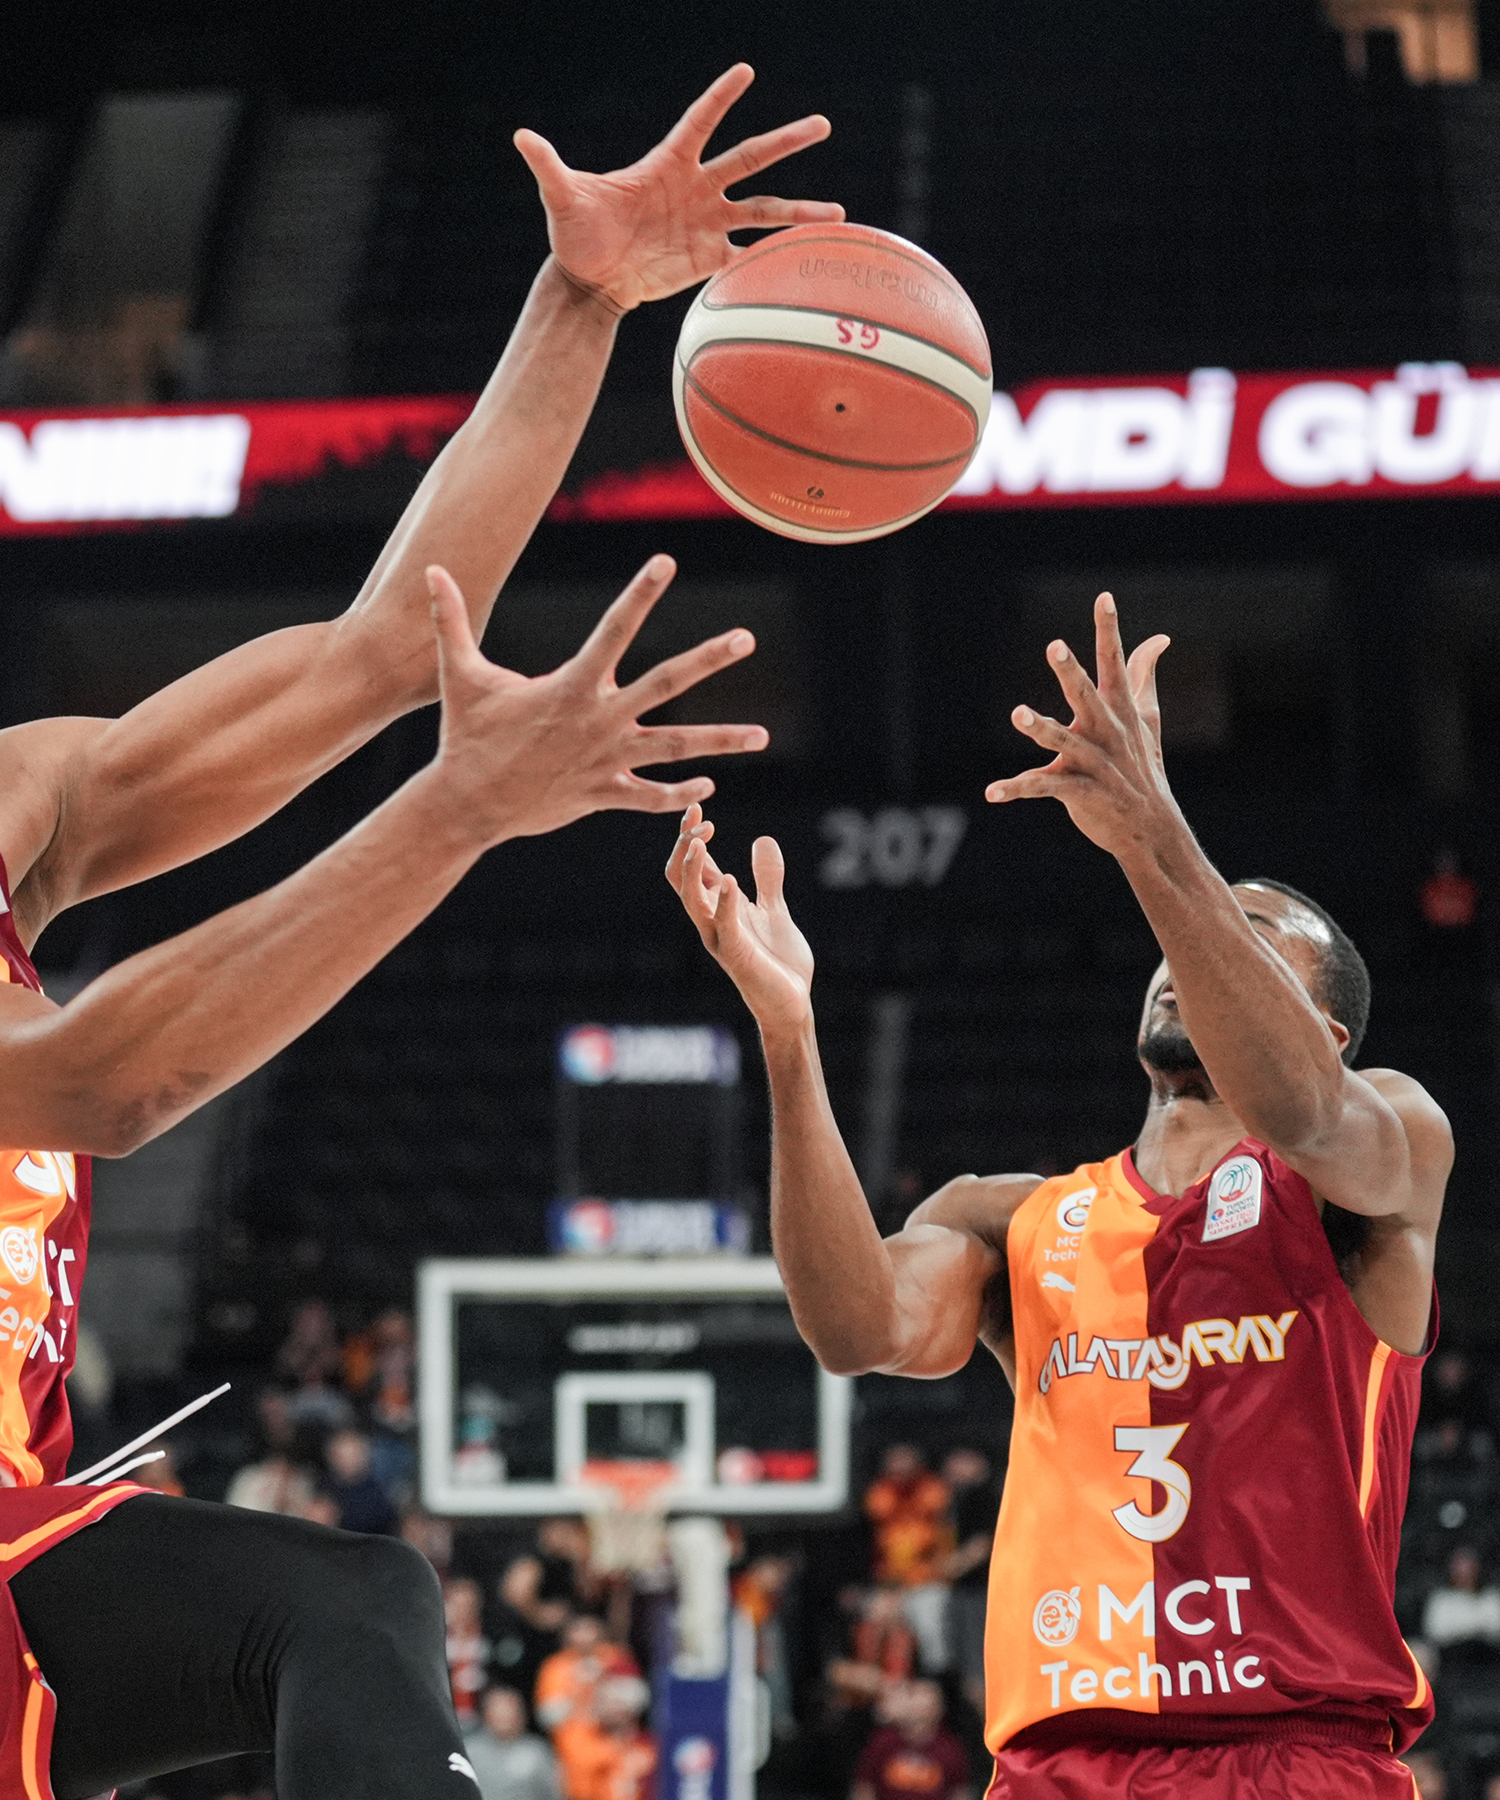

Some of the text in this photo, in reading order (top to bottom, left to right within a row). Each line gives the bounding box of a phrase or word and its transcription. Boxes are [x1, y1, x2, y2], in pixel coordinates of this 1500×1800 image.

[836, 317, 880, 349] GS
[950, 367, 1237, 495] MDİ
[817, 804, 968, 889] 207
[1043, 1248, 1078, 1262] Tech
[1056, 1235, 1081, 1248] MC
[1111, 1422, 1192, 1543] 3
[1098, 1575, 1251, 1641] MCT
[1040, 1649, 1266, 1709] Technic
